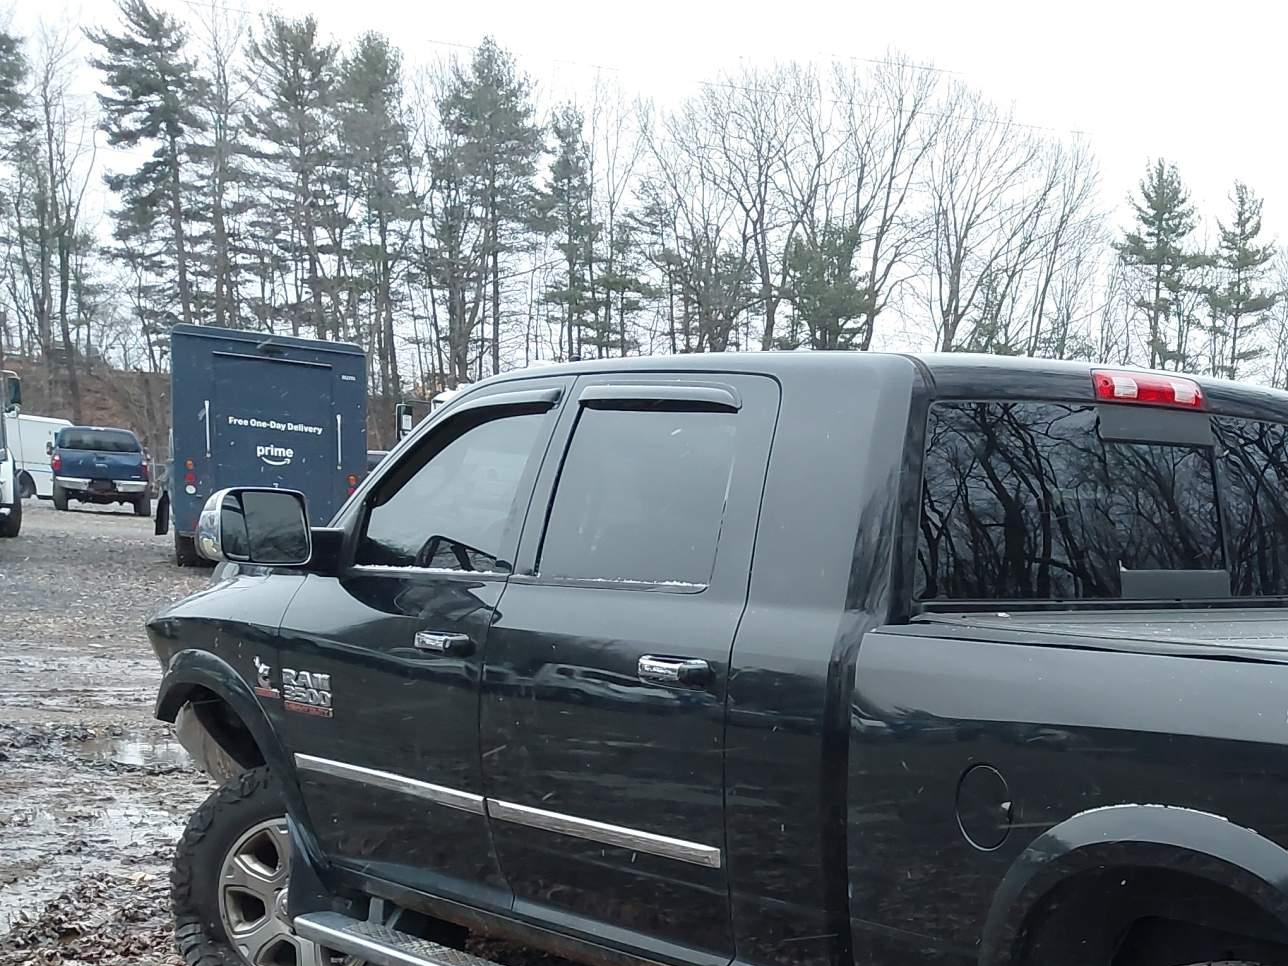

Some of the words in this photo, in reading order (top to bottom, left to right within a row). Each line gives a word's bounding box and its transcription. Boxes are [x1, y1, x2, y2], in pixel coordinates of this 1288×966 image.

[229, 416, 249, 427] Free
[250, 419, 286, 432] One-Day
[287, 422, 323, 435] Delivery
[256, 444, 294, 457] prime
[282, 668, 331, 691] RAM
